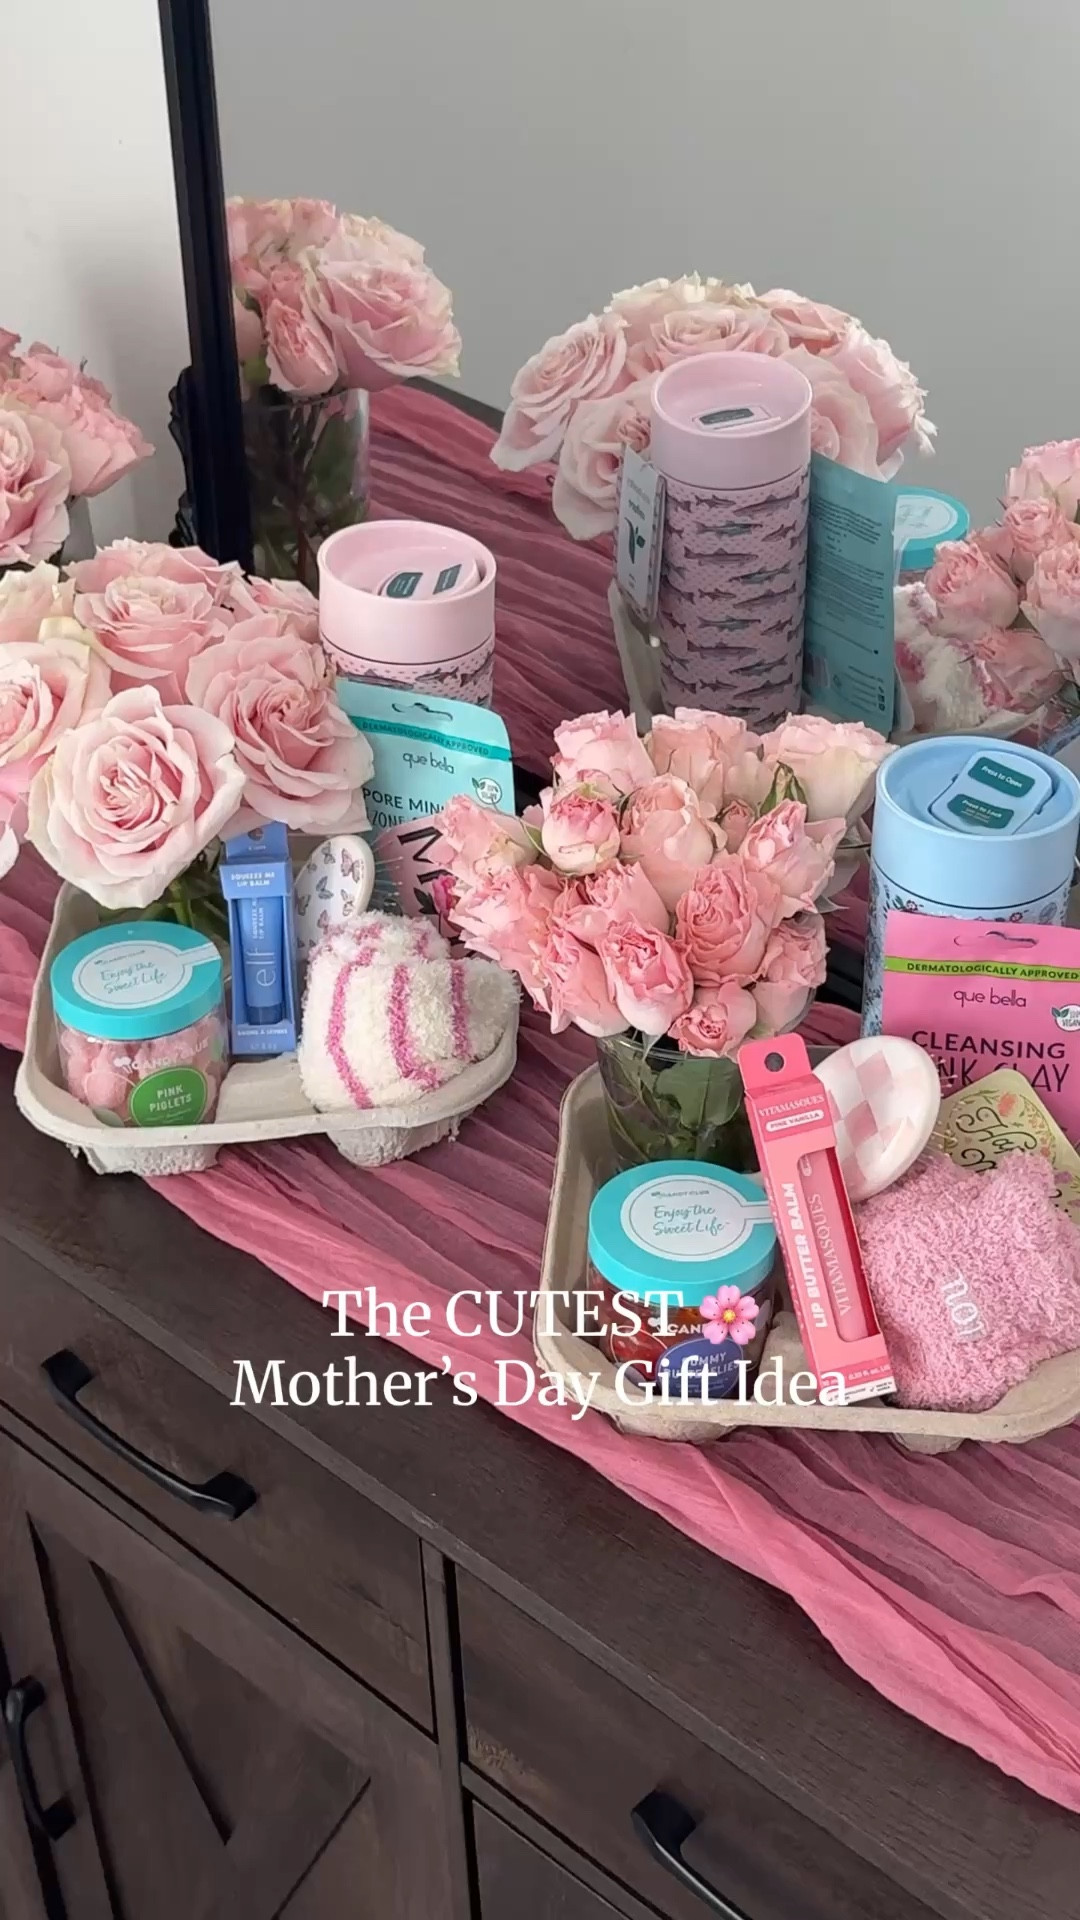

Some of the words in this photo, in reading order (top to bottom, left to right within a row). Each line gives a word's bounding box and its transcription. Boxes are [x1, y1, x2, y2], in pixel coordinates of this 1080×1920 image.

[446, 740, 489, 756] APPROVED
[402, 752, 428, 769] que
[981, 764, 998, 778] Press
[998, 772, 1006, 781] to
[1006, 776, 1023, 788] Open
[362, 787, 404, 810] PORE
[961, 799, 978, 811] Press
[979, 805, 987, 813] to
[987, 806, 1002, 818] Lock
[236, 880, 248, 888] LIP
[249, 879, 271, 887] BALM
[907, 962, 1018, 977] DERMATOLOGICALLY
[1019, 968, 1080, 980] APPROVED
[952, 989, 986, 1009] que
[989, 986, 1027, 1008] bella
[911, 1030, 1066, 1060] CLEANSING
[156, 1083, 184, 1099] PINK
[149, 1093, 193, 1113] PIGLETS
[758, 1094, 826, 1117] VITAMASQUES
[789, 1112, 821, 1124] VANILLA
[653, 1205, 690, 1223] Enjoy
[689, 1203, 716, 1216] the
[781, 1182, 805, 1231] BALM
[652, 1221, 694, 1236] Sweet
[695, 1216, 725, 1237] Life
[807, 1193, 851, 1316] VITAMASQUES
[794, 1234, 821, 1299] BUTTER
[810, 1301, 829, 1329] LIP
